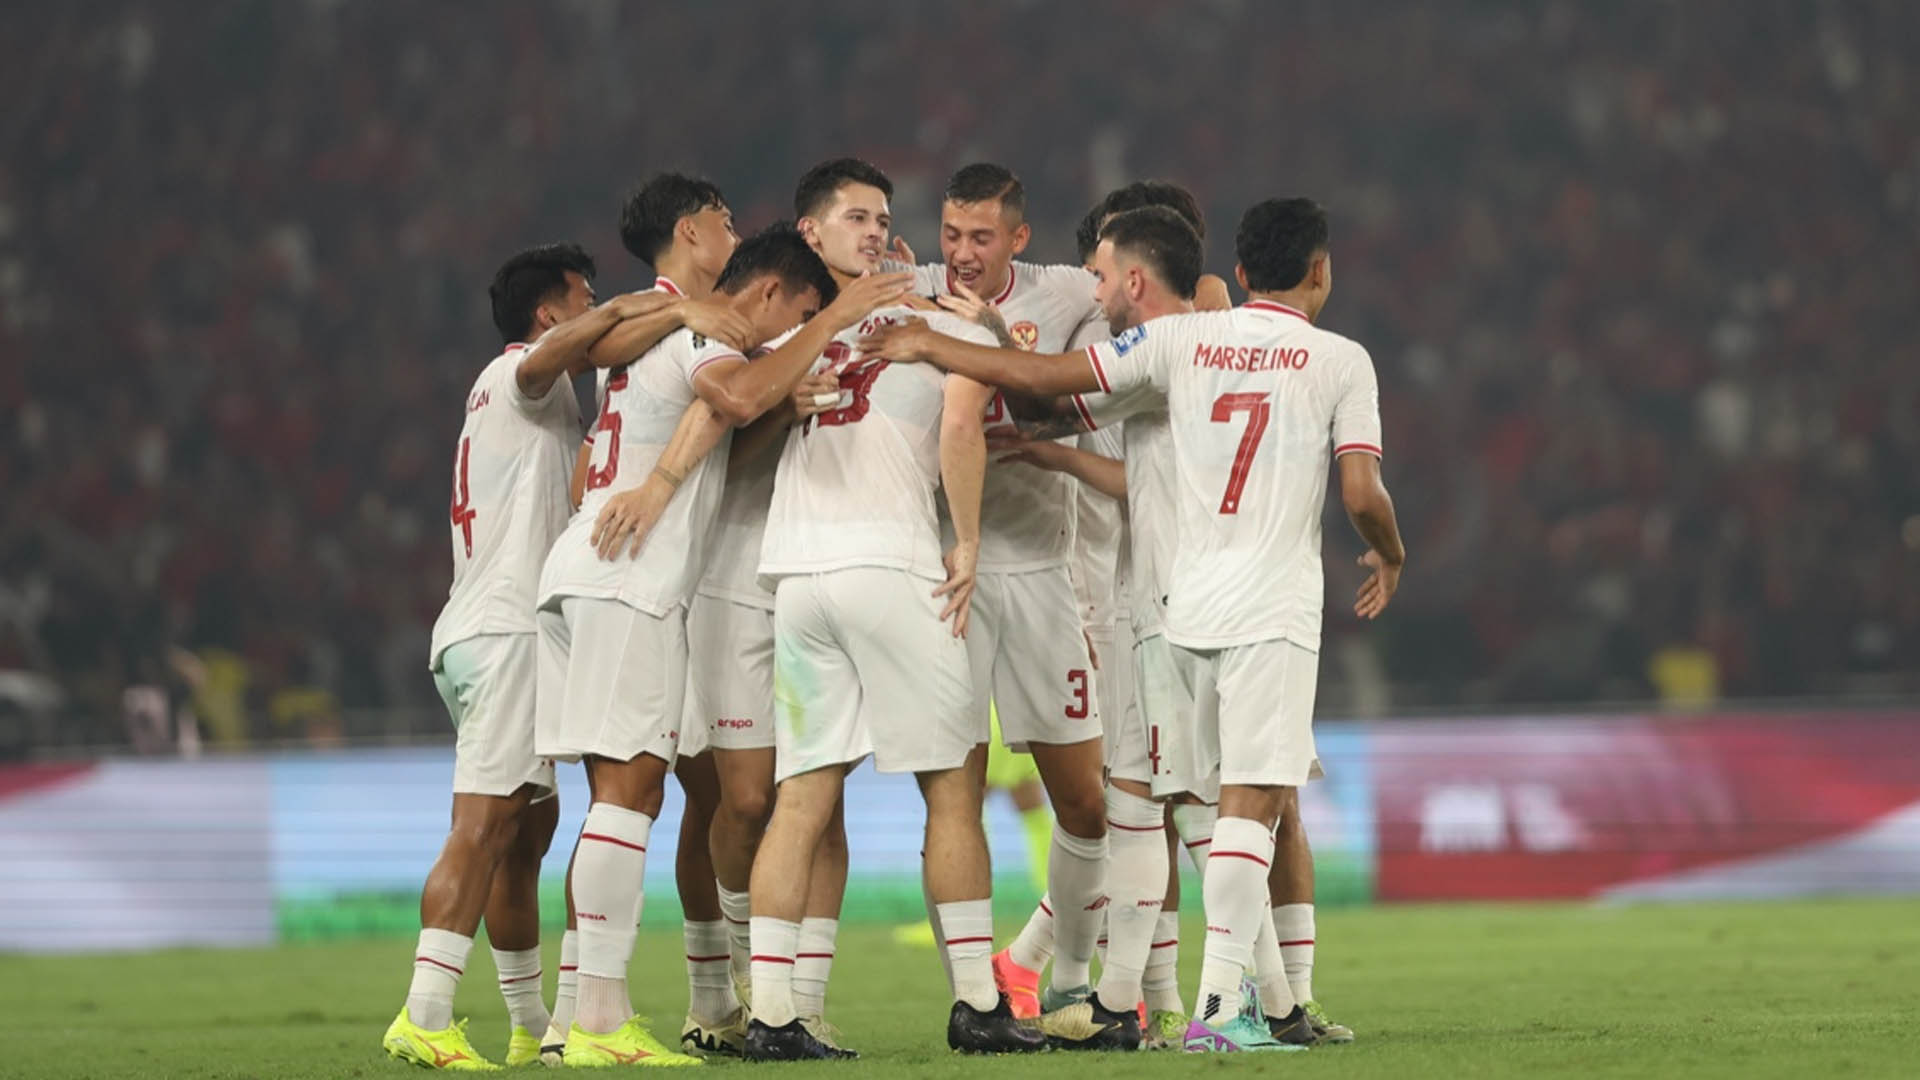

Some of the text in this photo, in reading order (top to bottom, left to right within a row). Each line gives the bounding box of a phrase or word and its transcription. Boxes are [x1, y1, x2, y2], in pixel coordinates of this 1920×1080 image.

[1193, 342, 1309, 372] MARSELINO
[587, 372, 628, 492] 5
[1210, 392, 1271, 514] 7
[452, 436, 477, 560] 4
[717, 718, 754, 730] erspo
[1065, 669, 1088, 719] 3
